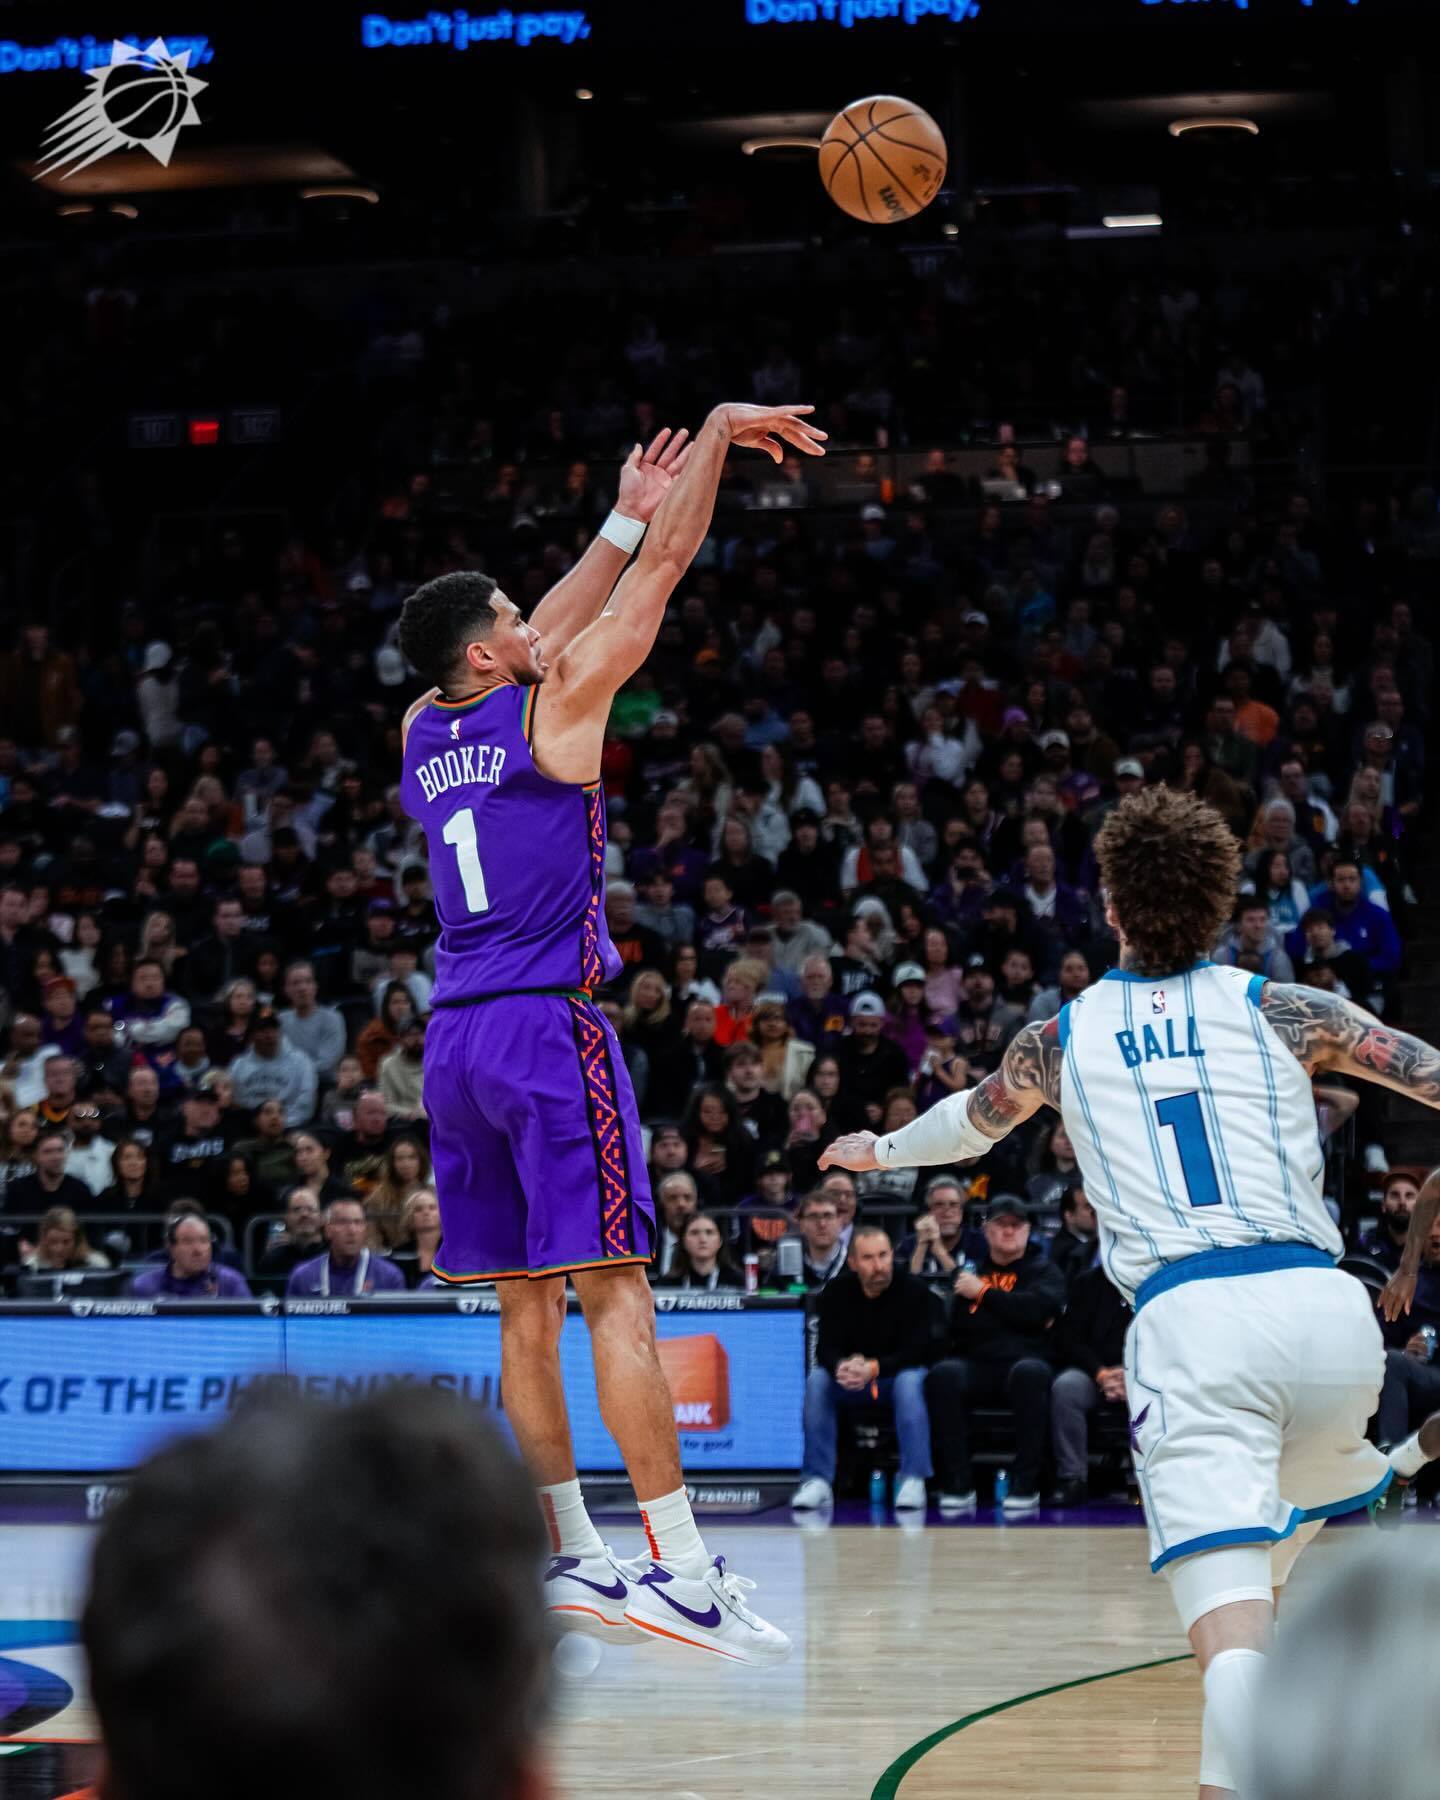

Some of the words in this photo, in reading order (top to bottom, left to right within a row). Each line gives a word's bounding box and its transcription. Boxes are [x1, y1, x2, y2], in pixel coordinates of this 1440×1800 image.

[362, 12, 450, 48] Don't
[453, 9, 513, 50] just
[515, 11, 592, 47] pay,
[746, 0, 836, 24] Dont
[416, 745, 506, 803] BOOKER
[442, 808, 489, 913] 1
[1115, 1016, 1205, 1068] BALL
[1154, 1090, 1223, 1208] 1
[287, 1302, 352, 1315] FANDUEL
[677, 1296, 744, 1310] FANDUEL
[23, 1377, 85, 1414] OF
[95, 1376, 188, 1414] THE
[674, 1402, 712, 1424] ANK
